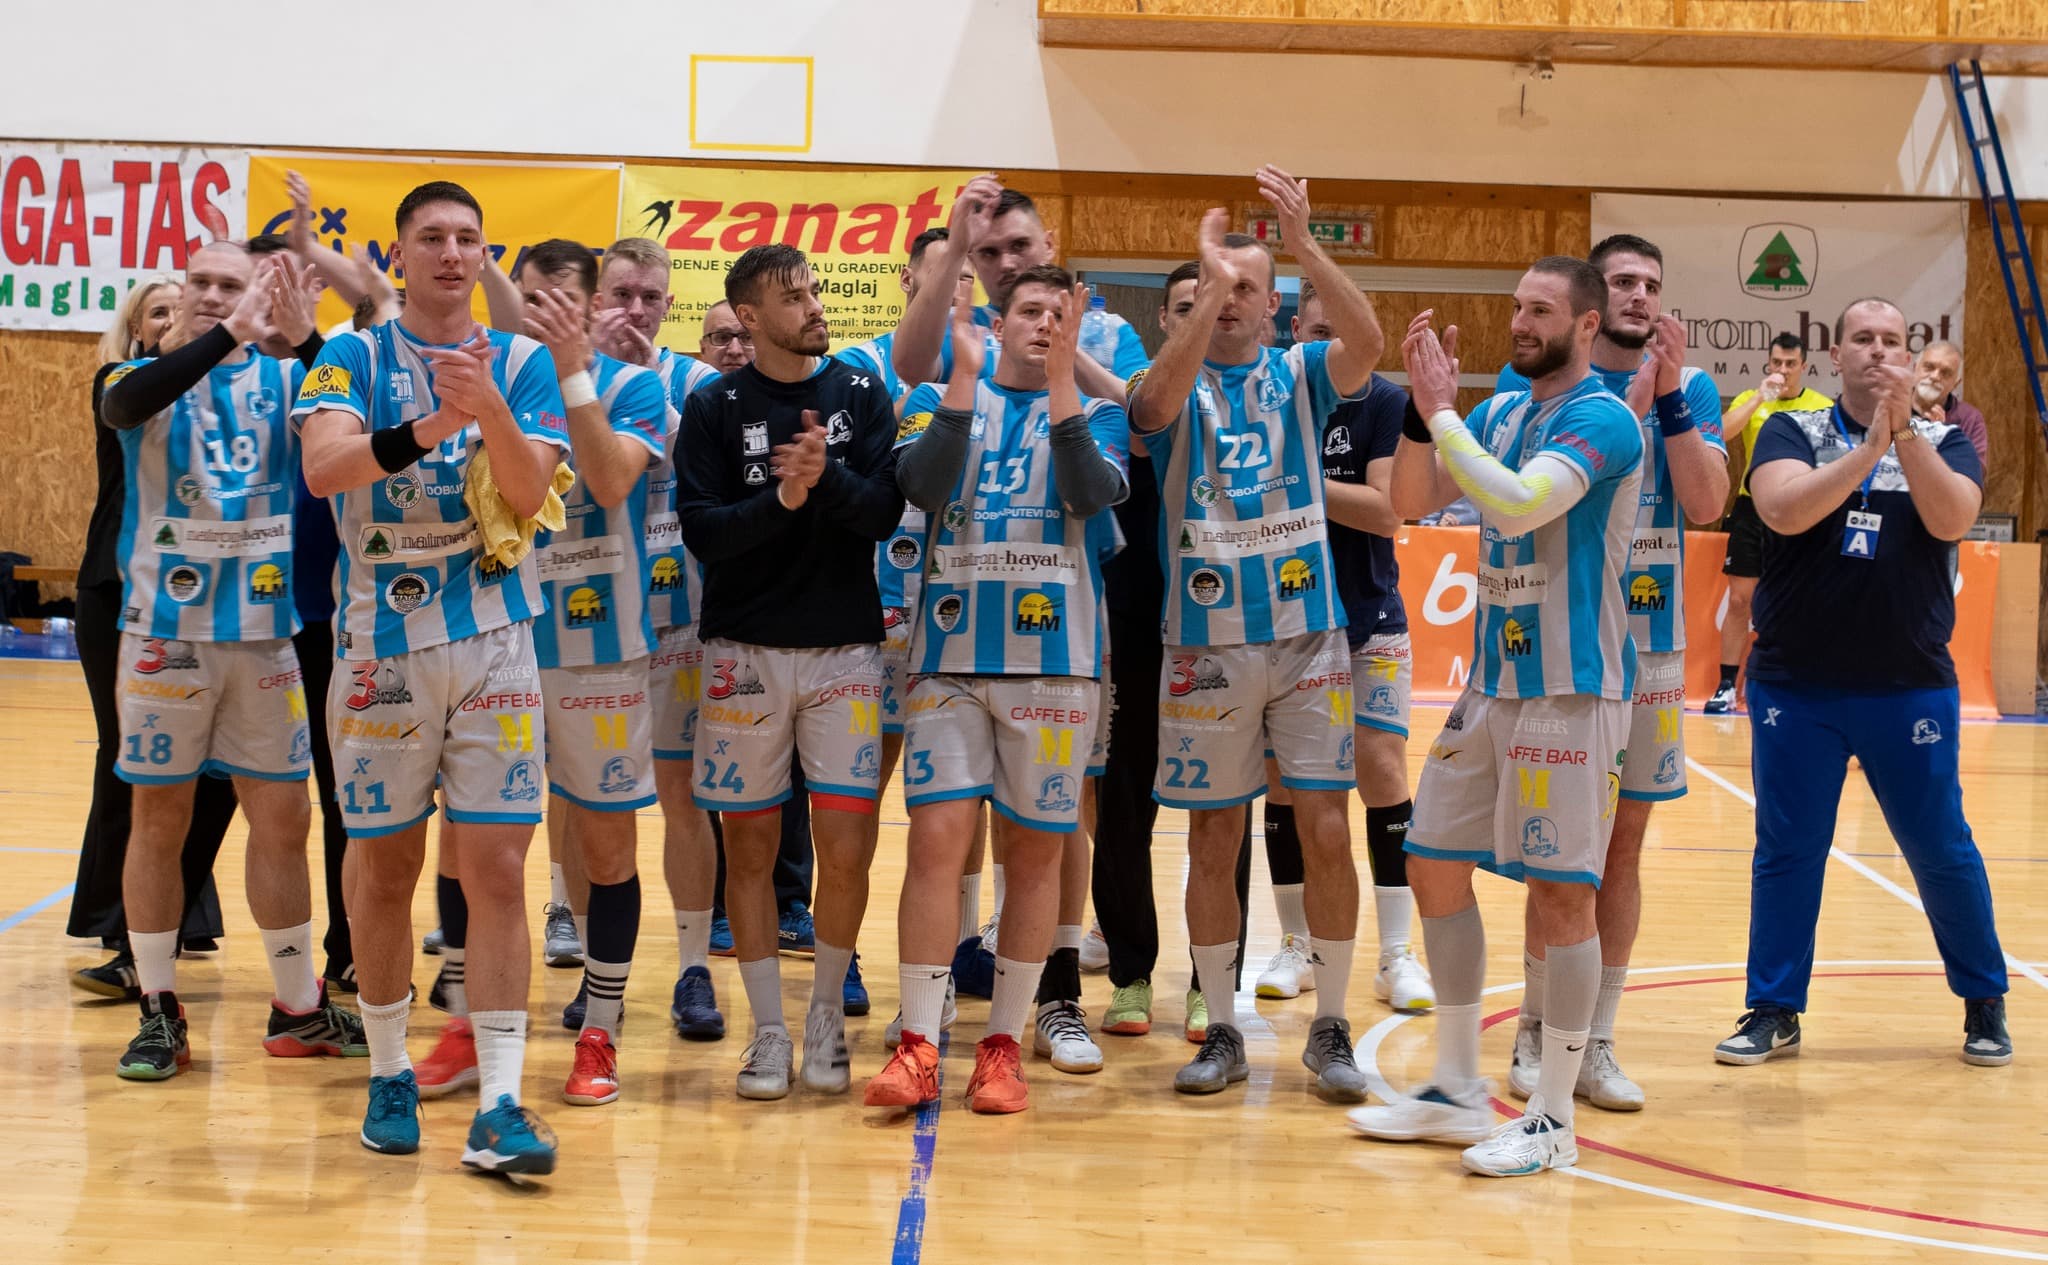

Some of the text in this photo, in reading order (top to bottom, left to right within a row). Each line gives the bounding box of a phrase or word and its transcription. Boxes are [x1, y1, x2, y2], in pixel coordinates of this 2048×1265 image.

[824, 263, 833, 274] U
[819, 279, 877, 297] Maglaj
[862, 305, 882, 314] 387
[887, 305, 902, 317] (0)
[827, 319, 859, 328] -mail:
[206, 436, 257, 473] 18
[1219, 433, 1267, 469] 22
[978, 454, 1027, 495] 13
[1847, 531, 1869, 555] A
[651, 575, 683, 592] H-M
[1280, 574, 1316, 598] H-M
[1628, 595, 1666, 611] H-M
[567, 606, 607, 626] H-M
[1016, 614, 1060, 631] H-M
[462, 693, 542, 712] CAFFE BA
[560, 697, 616, 710] CAFFE
[820, 684, 871, 704] CAFFE
[1010, 706, 1065, 723] CAFFE
[125, 732, 173, 765] 18
[1033, 727, 1075, 766] M
[1546, 749, 1588, 765] BAR
[700, 758, 744, 794] 24
[1165, 756, 1211, 789] 22
[343, 781, 392, 815] 11
[1386, 821, 1410, 831] SELE
